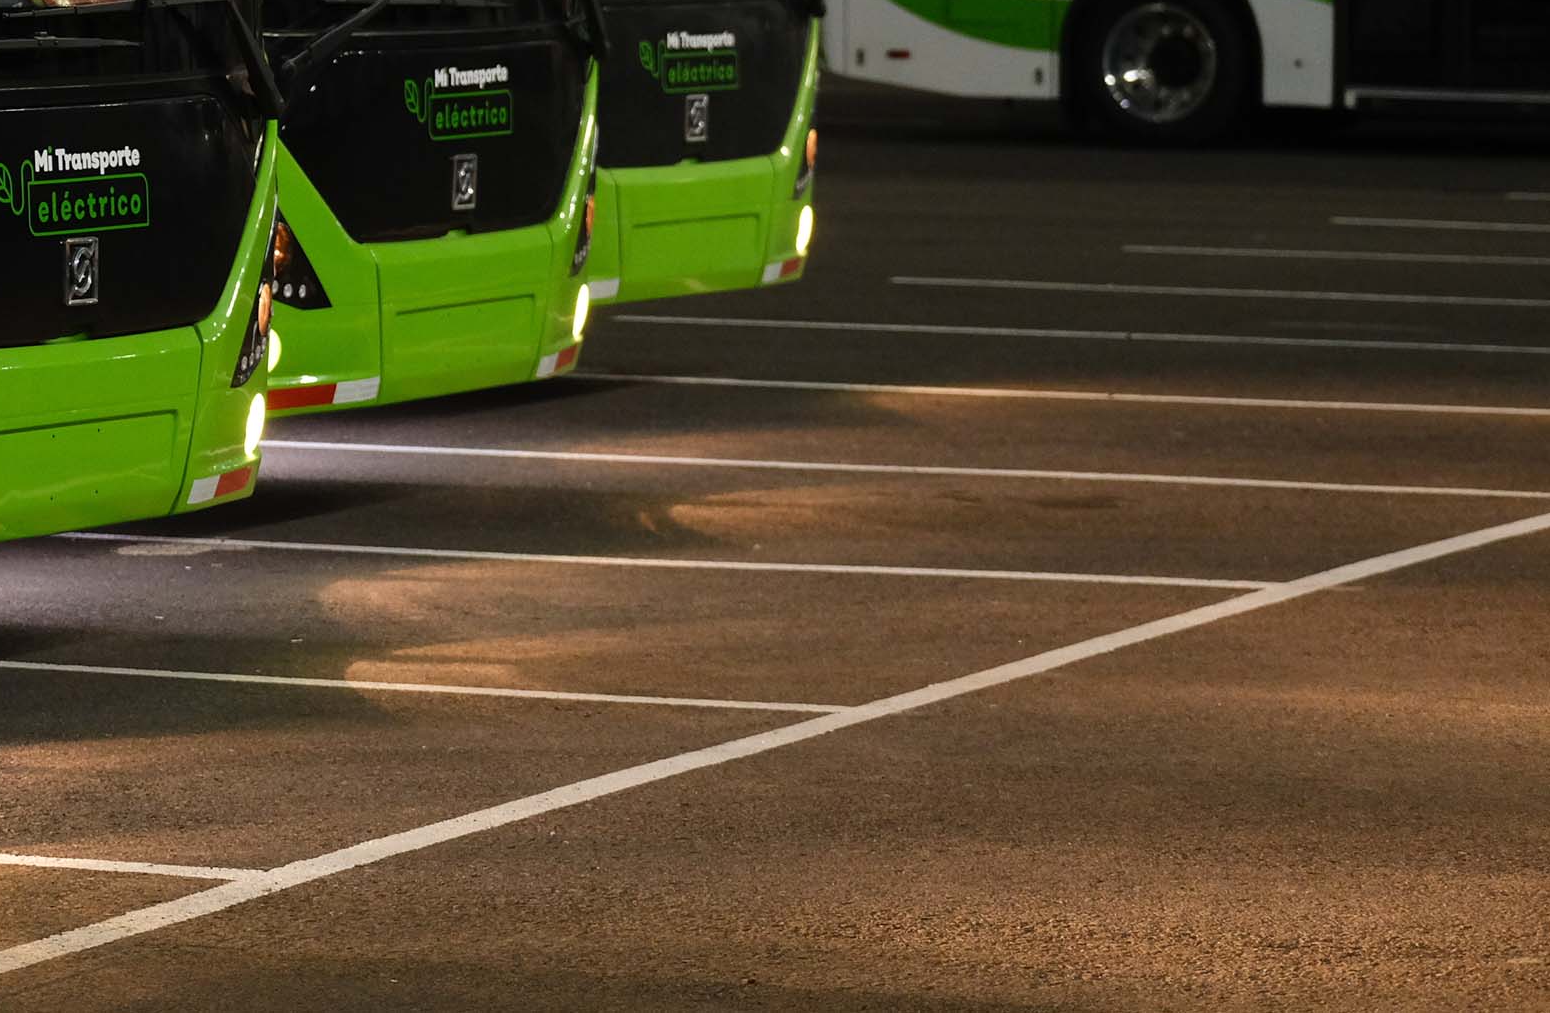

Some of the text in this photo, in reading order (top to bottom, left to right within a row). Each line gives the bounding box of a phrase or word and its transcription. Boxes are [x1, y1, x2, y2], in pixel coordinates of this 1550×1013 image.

[434, 64, 509, 89] Mi Transporte
[435, 100, 508, 129] eléctrico
[34, 146, 140, 175] Mi Transporte
[38, 186, 142, 223] eléctrico
